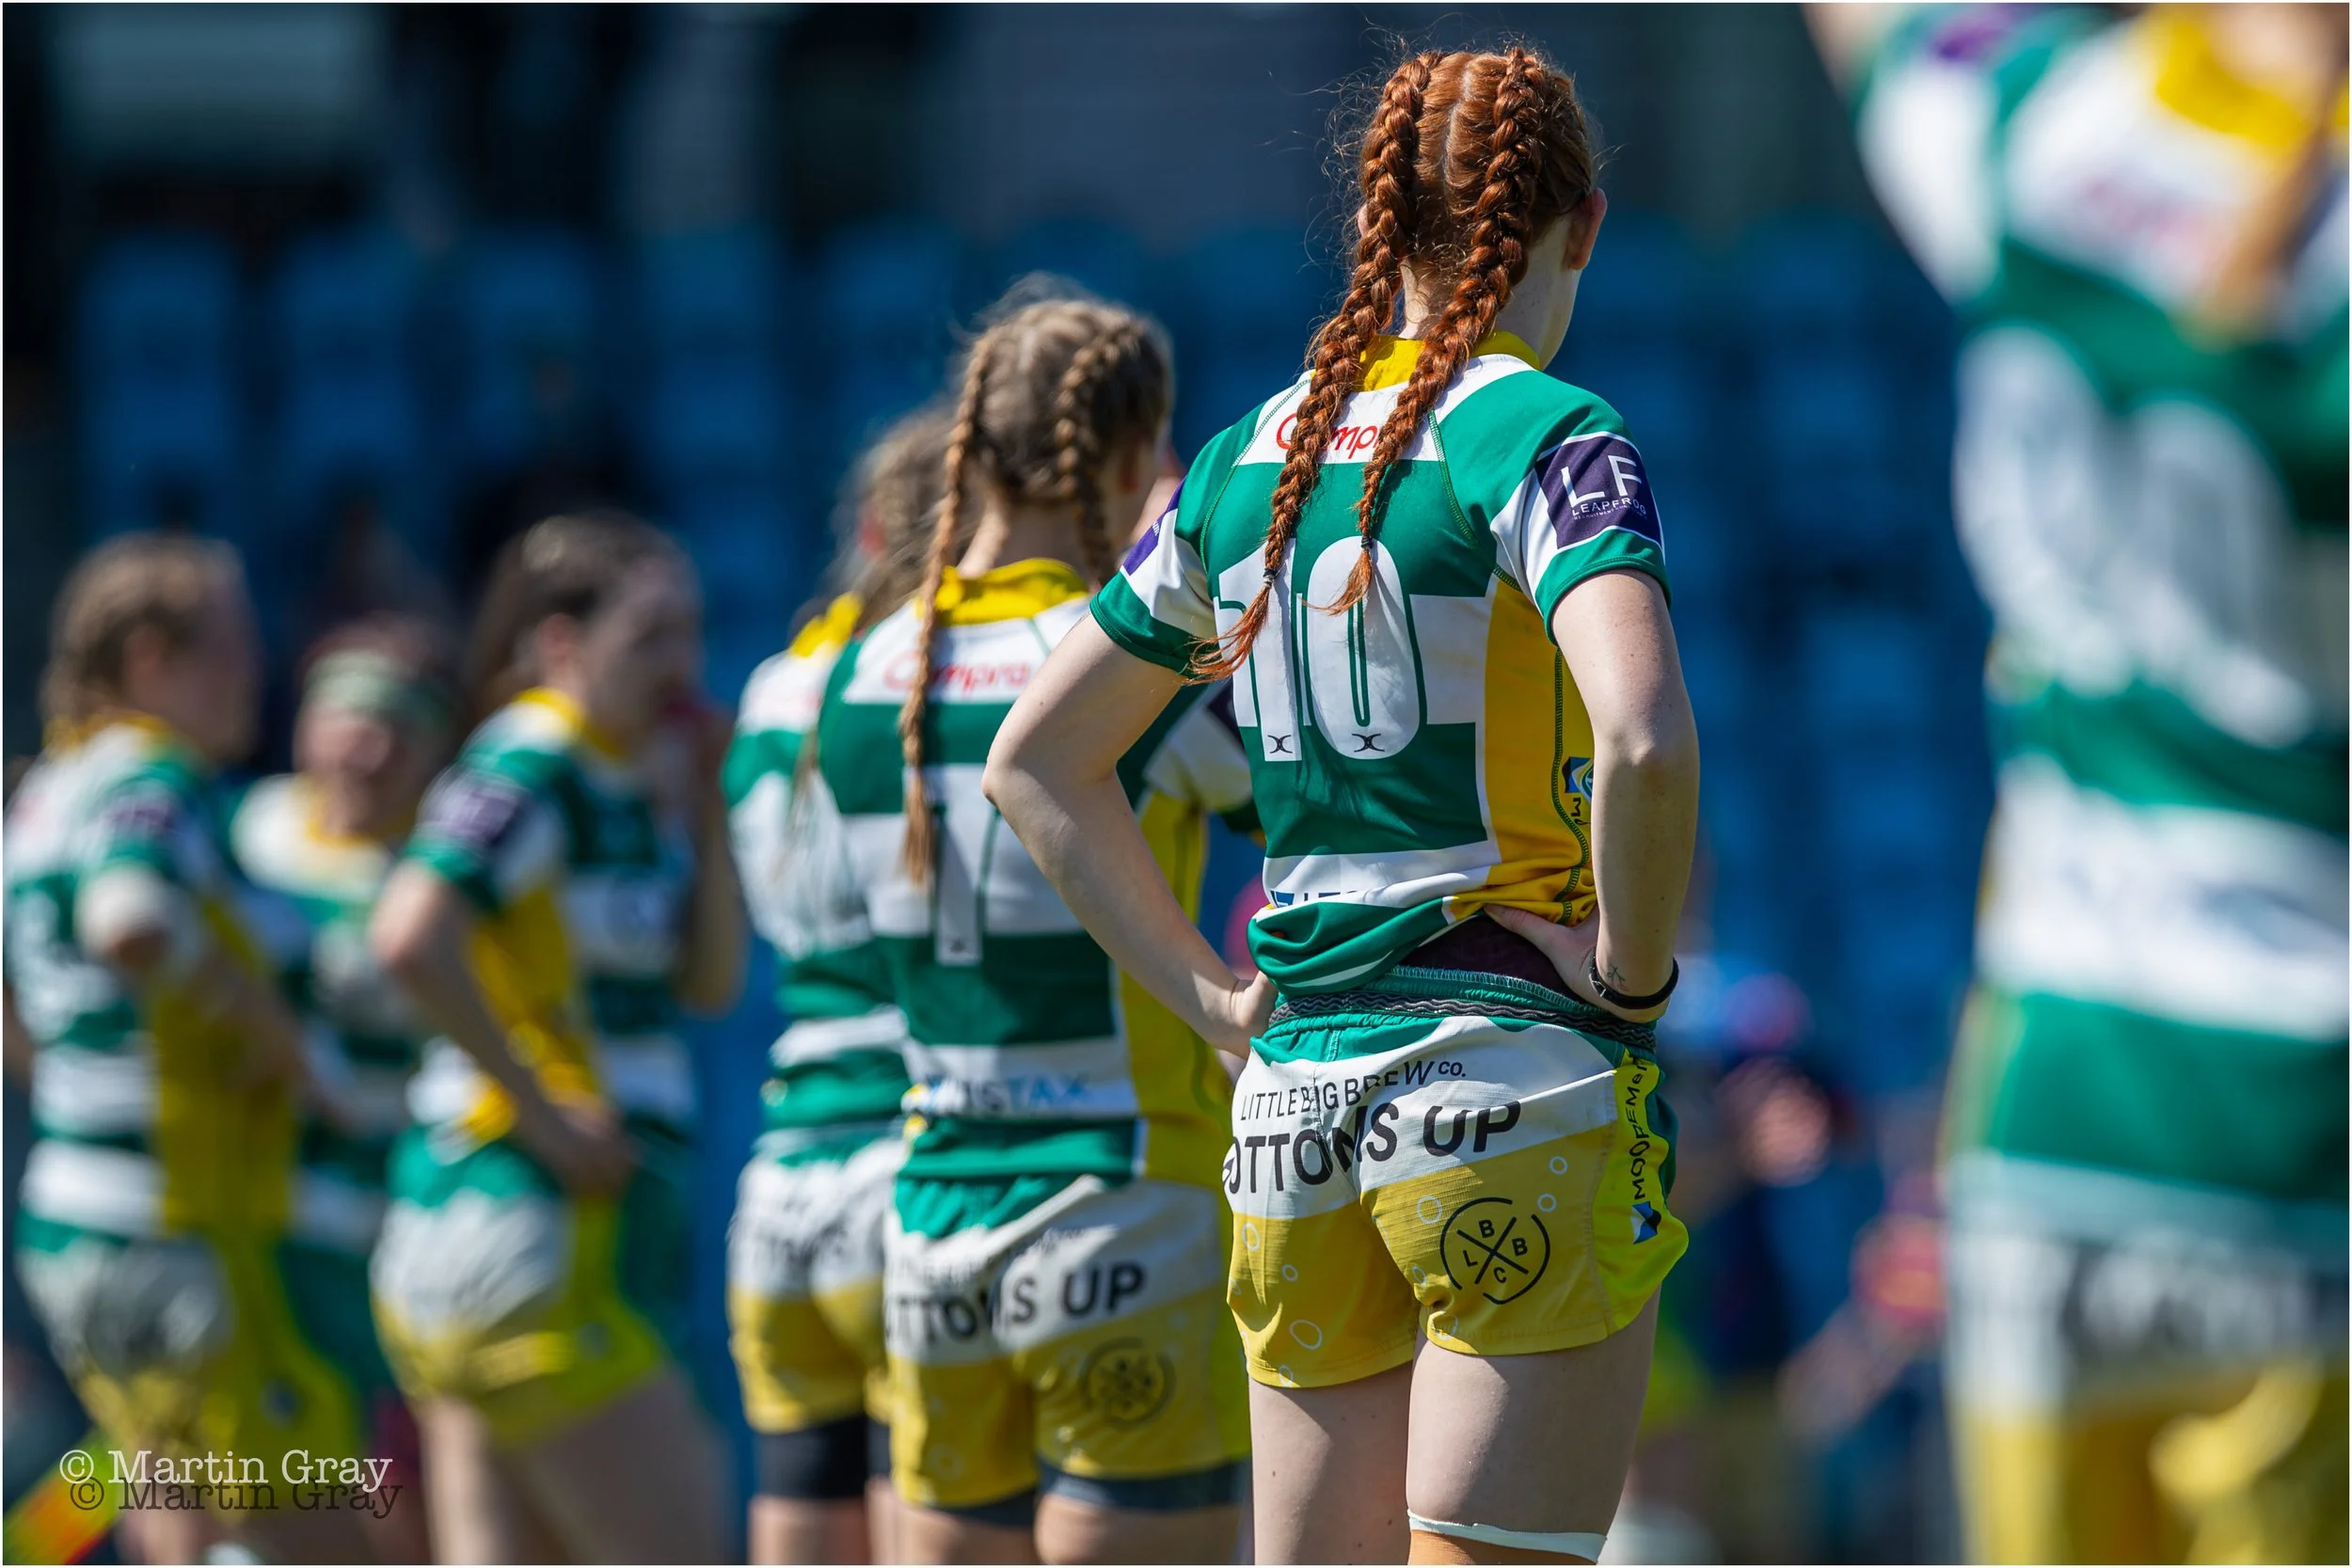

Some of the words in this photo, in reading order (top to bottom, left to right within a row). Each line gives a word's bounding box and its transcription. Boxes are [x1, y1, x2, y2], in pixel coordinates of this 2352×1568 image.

[1561, 455, 1642, 508] LF
[1572, 497, 1646, 516] LEAPFROG
[1215, 536, 1421, 761] 10
[1438, 1060, 1467, 1078] CO.
[1222, 1101, 1400, 1195] OTTOMS
[1422, 1101, 1521, 1158] UP
[1062, 1262, 1144, 1318] UP
